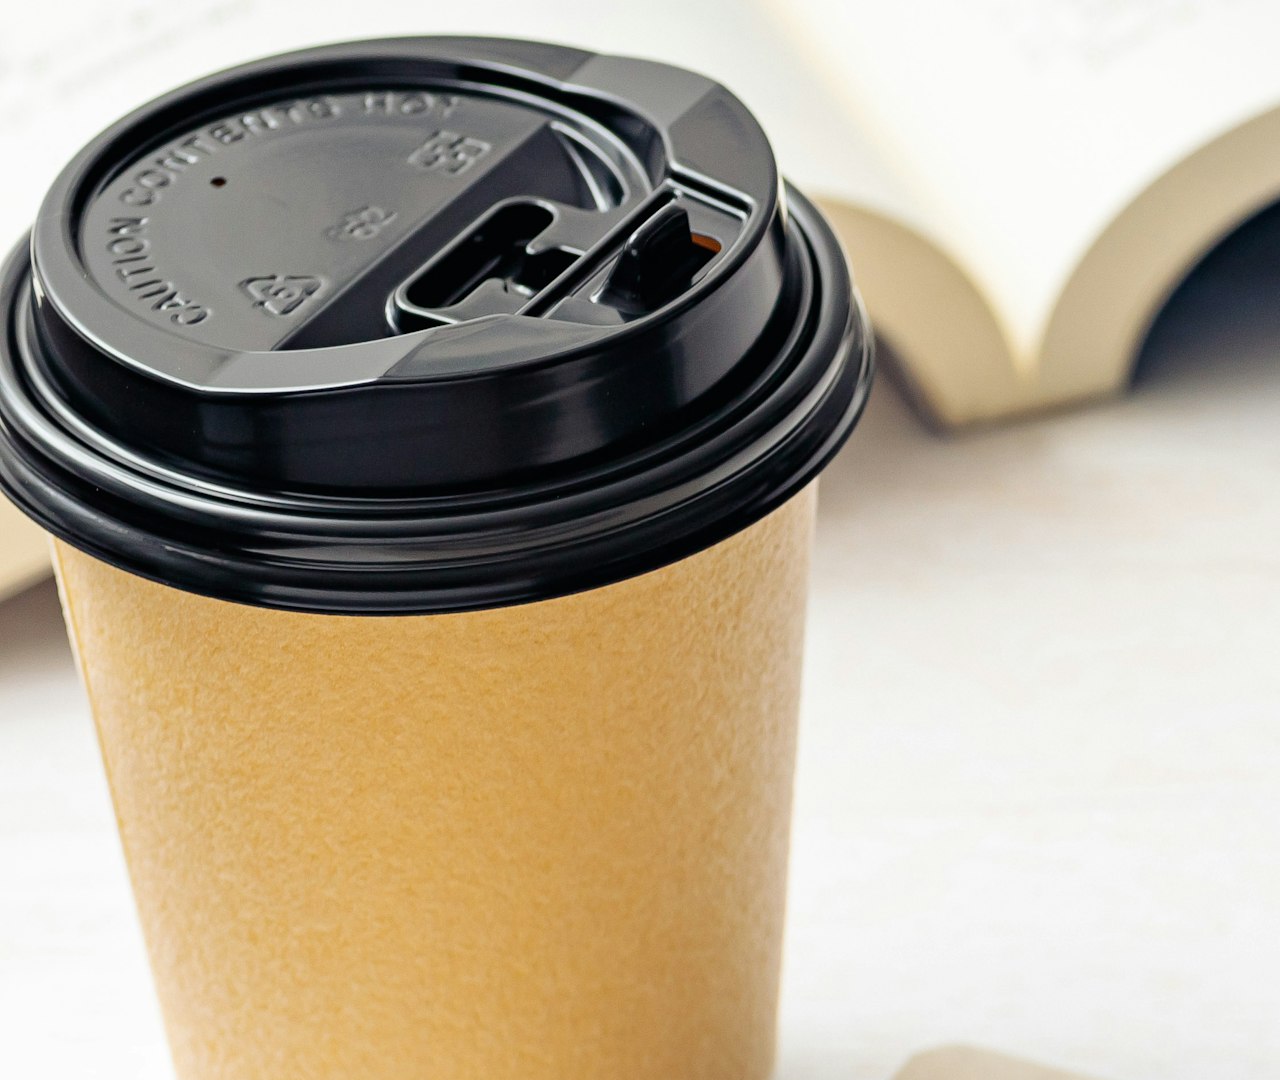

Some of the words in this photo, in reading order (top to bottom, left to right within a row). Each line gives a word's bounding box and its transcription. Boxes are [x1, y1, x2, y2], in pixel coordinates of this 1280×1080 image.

[119, 99, 342, 207] CONTENTS
[364, 92, 460, 117] HOT
[106, 215, 212, 325] CAUTION
